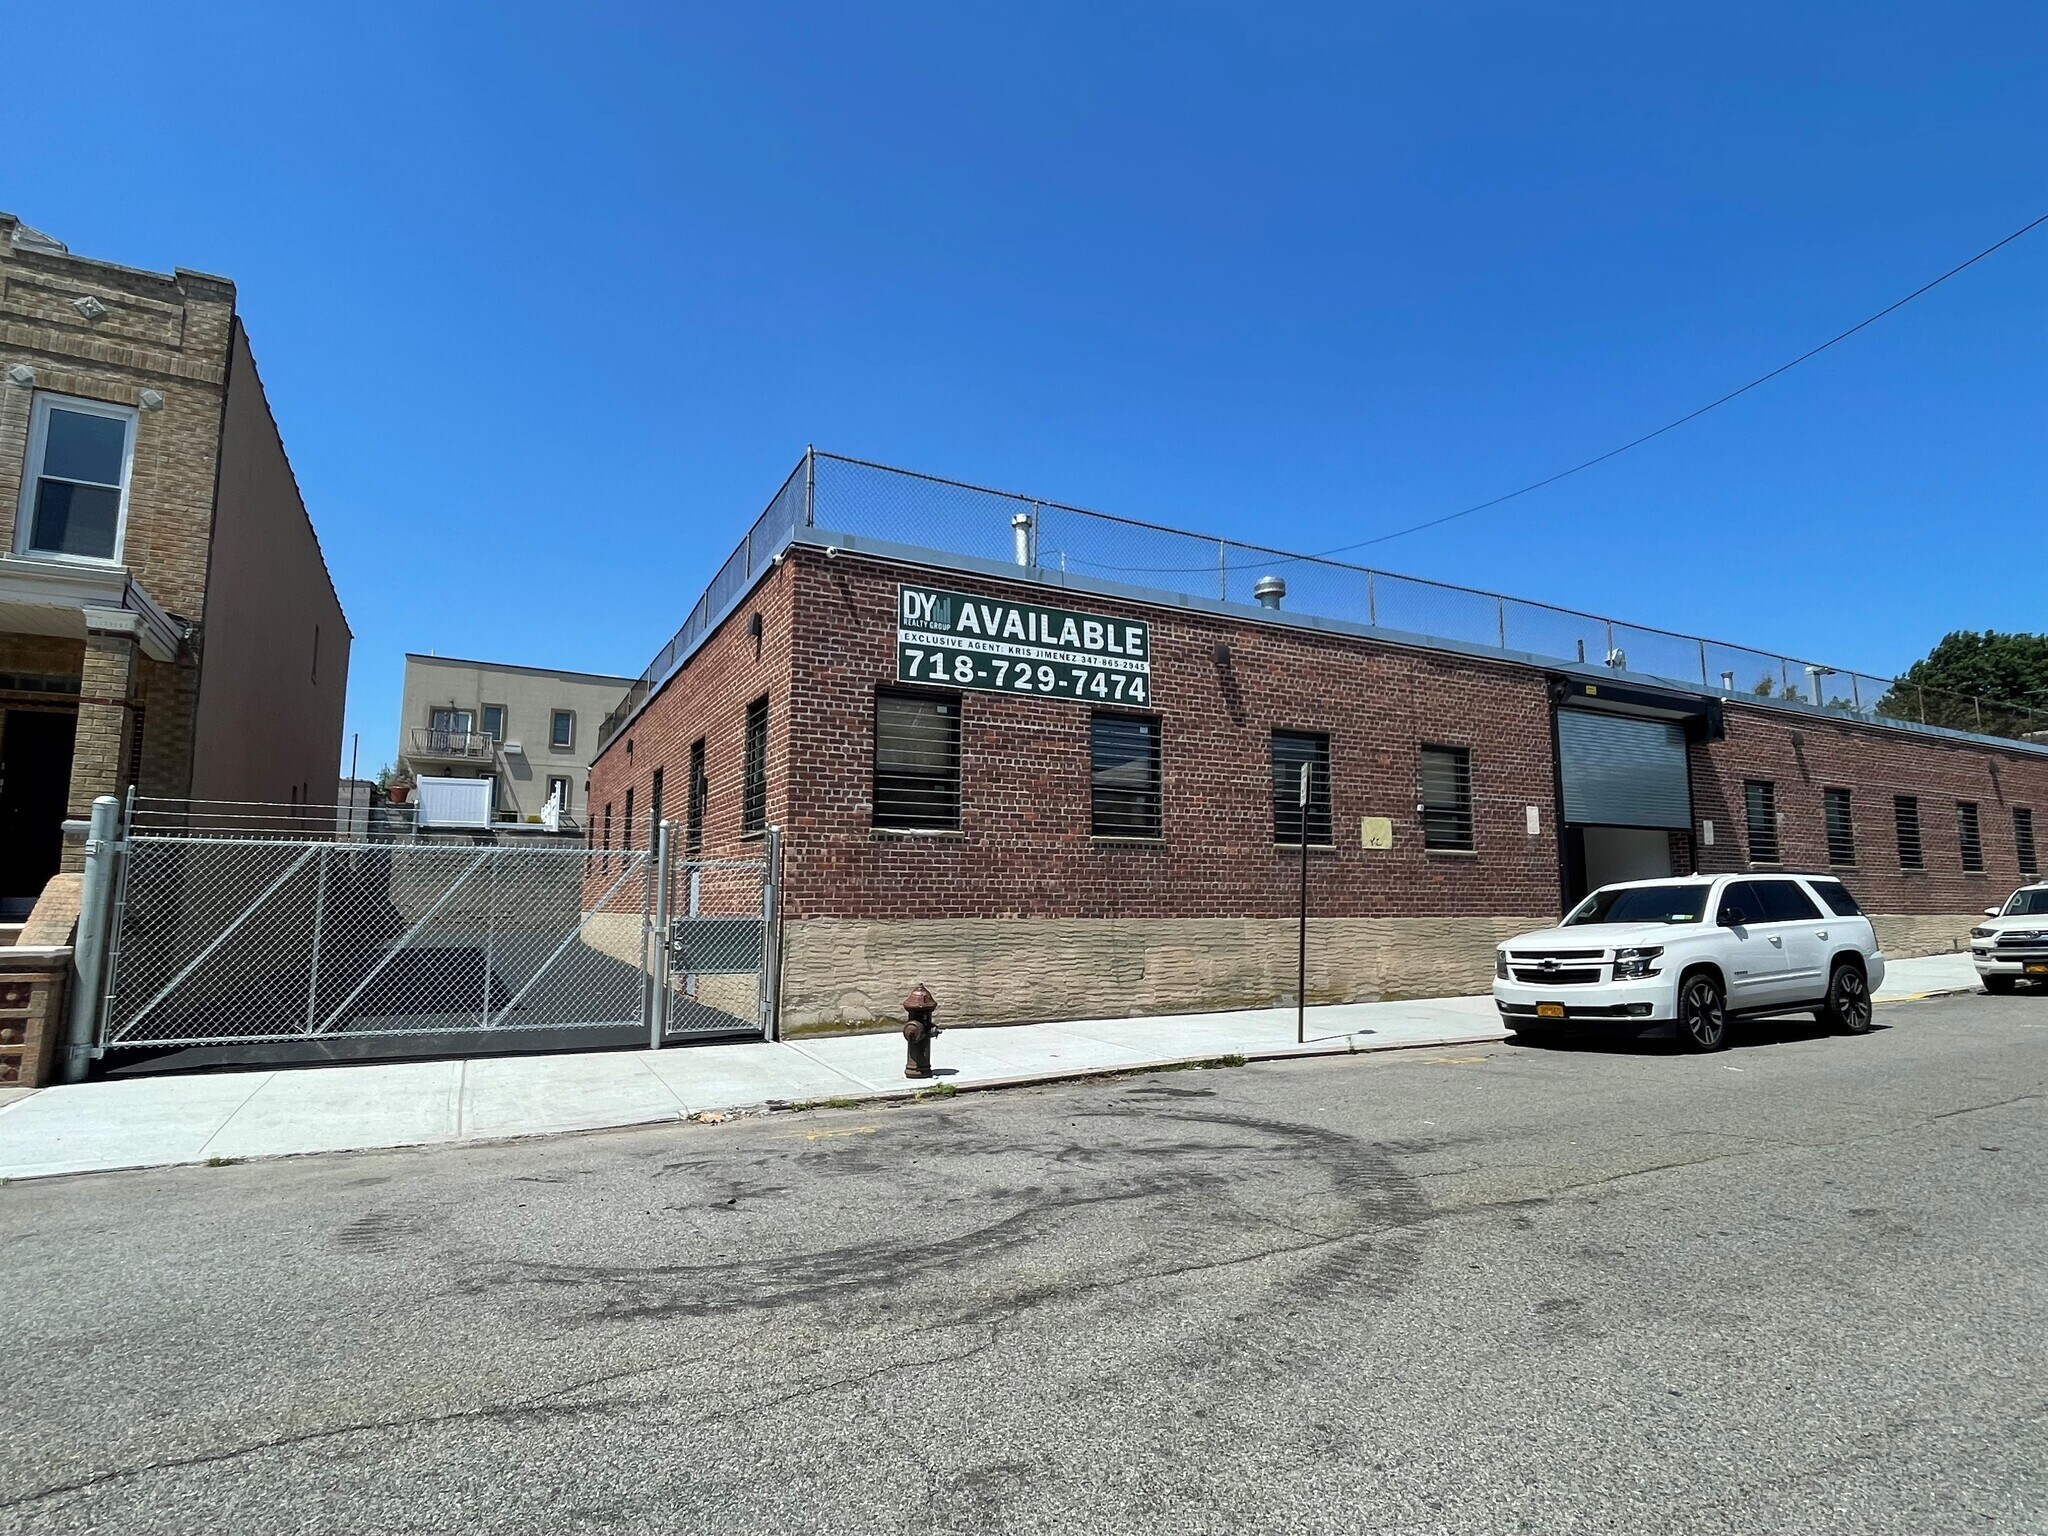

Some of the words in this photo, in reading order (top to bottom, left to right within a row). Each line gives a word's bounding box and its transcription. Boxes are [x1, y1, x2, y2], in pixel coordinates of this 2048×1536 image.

[903, 590, 938, 622] DY
[903, 617, 928, 629] REALTY
[929, 621, 951, 632] GROUP
[956, 602, 1144, 656] AVAILABLE
[904, 632, 963, 648] EXCLUSIVE
[967, 641, 1004, 653] AGENT:
[1008, 646, 1032, 656] KRIS
[1035, 650, 1077, 662] JIMENEZ
[904, 649, 1146, 703] 718-729-7474
